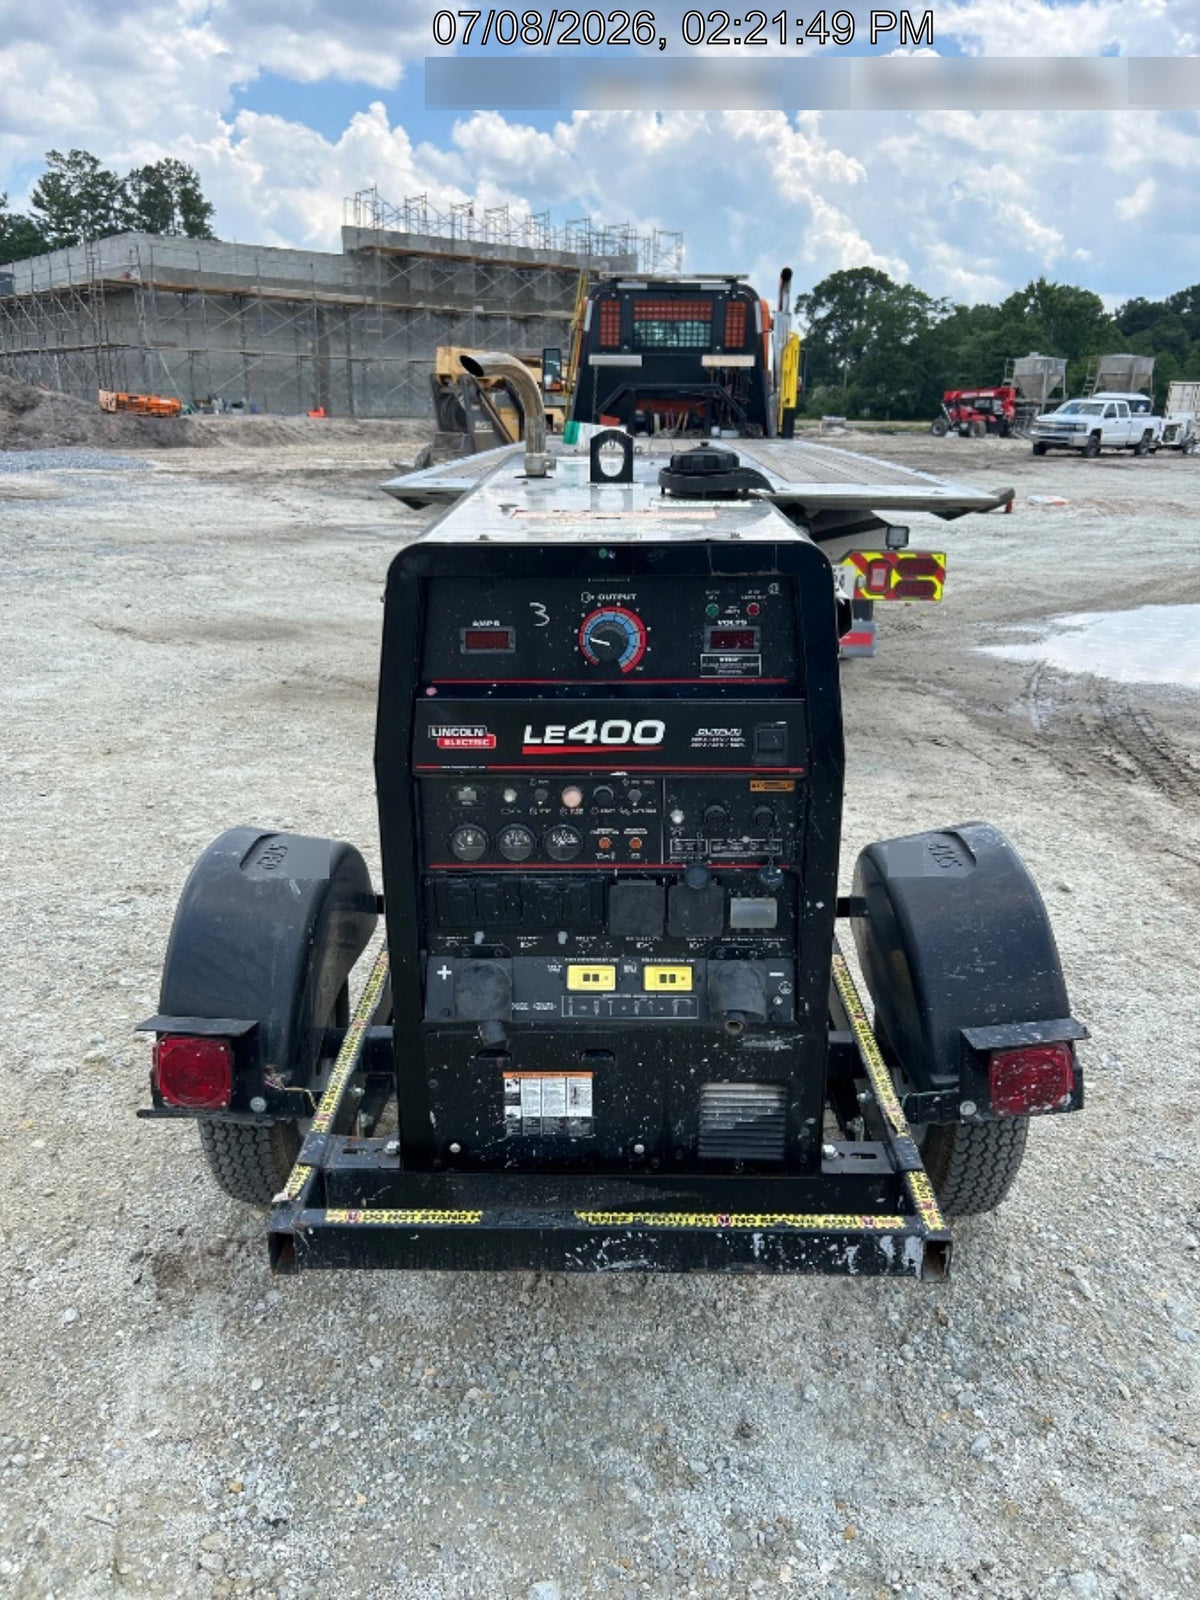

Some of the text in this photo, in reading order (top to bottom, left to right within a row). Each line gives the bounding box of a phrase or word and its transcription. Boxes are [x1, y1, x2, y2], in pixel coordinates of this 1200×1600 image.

[598, 593, 637, 601] OUTPUT
[529, 602, 550, 627] 3
[431, 727, 485, 737] LINCOLN
[523, 719, 666, 744] LE400
[444, 738, 491, 746] ELECTRIC
[363, 1212, 384, 1221] DO
[387, 1212, 418, 1221] NOT
[420, 1212, 468, 1221] STAND
